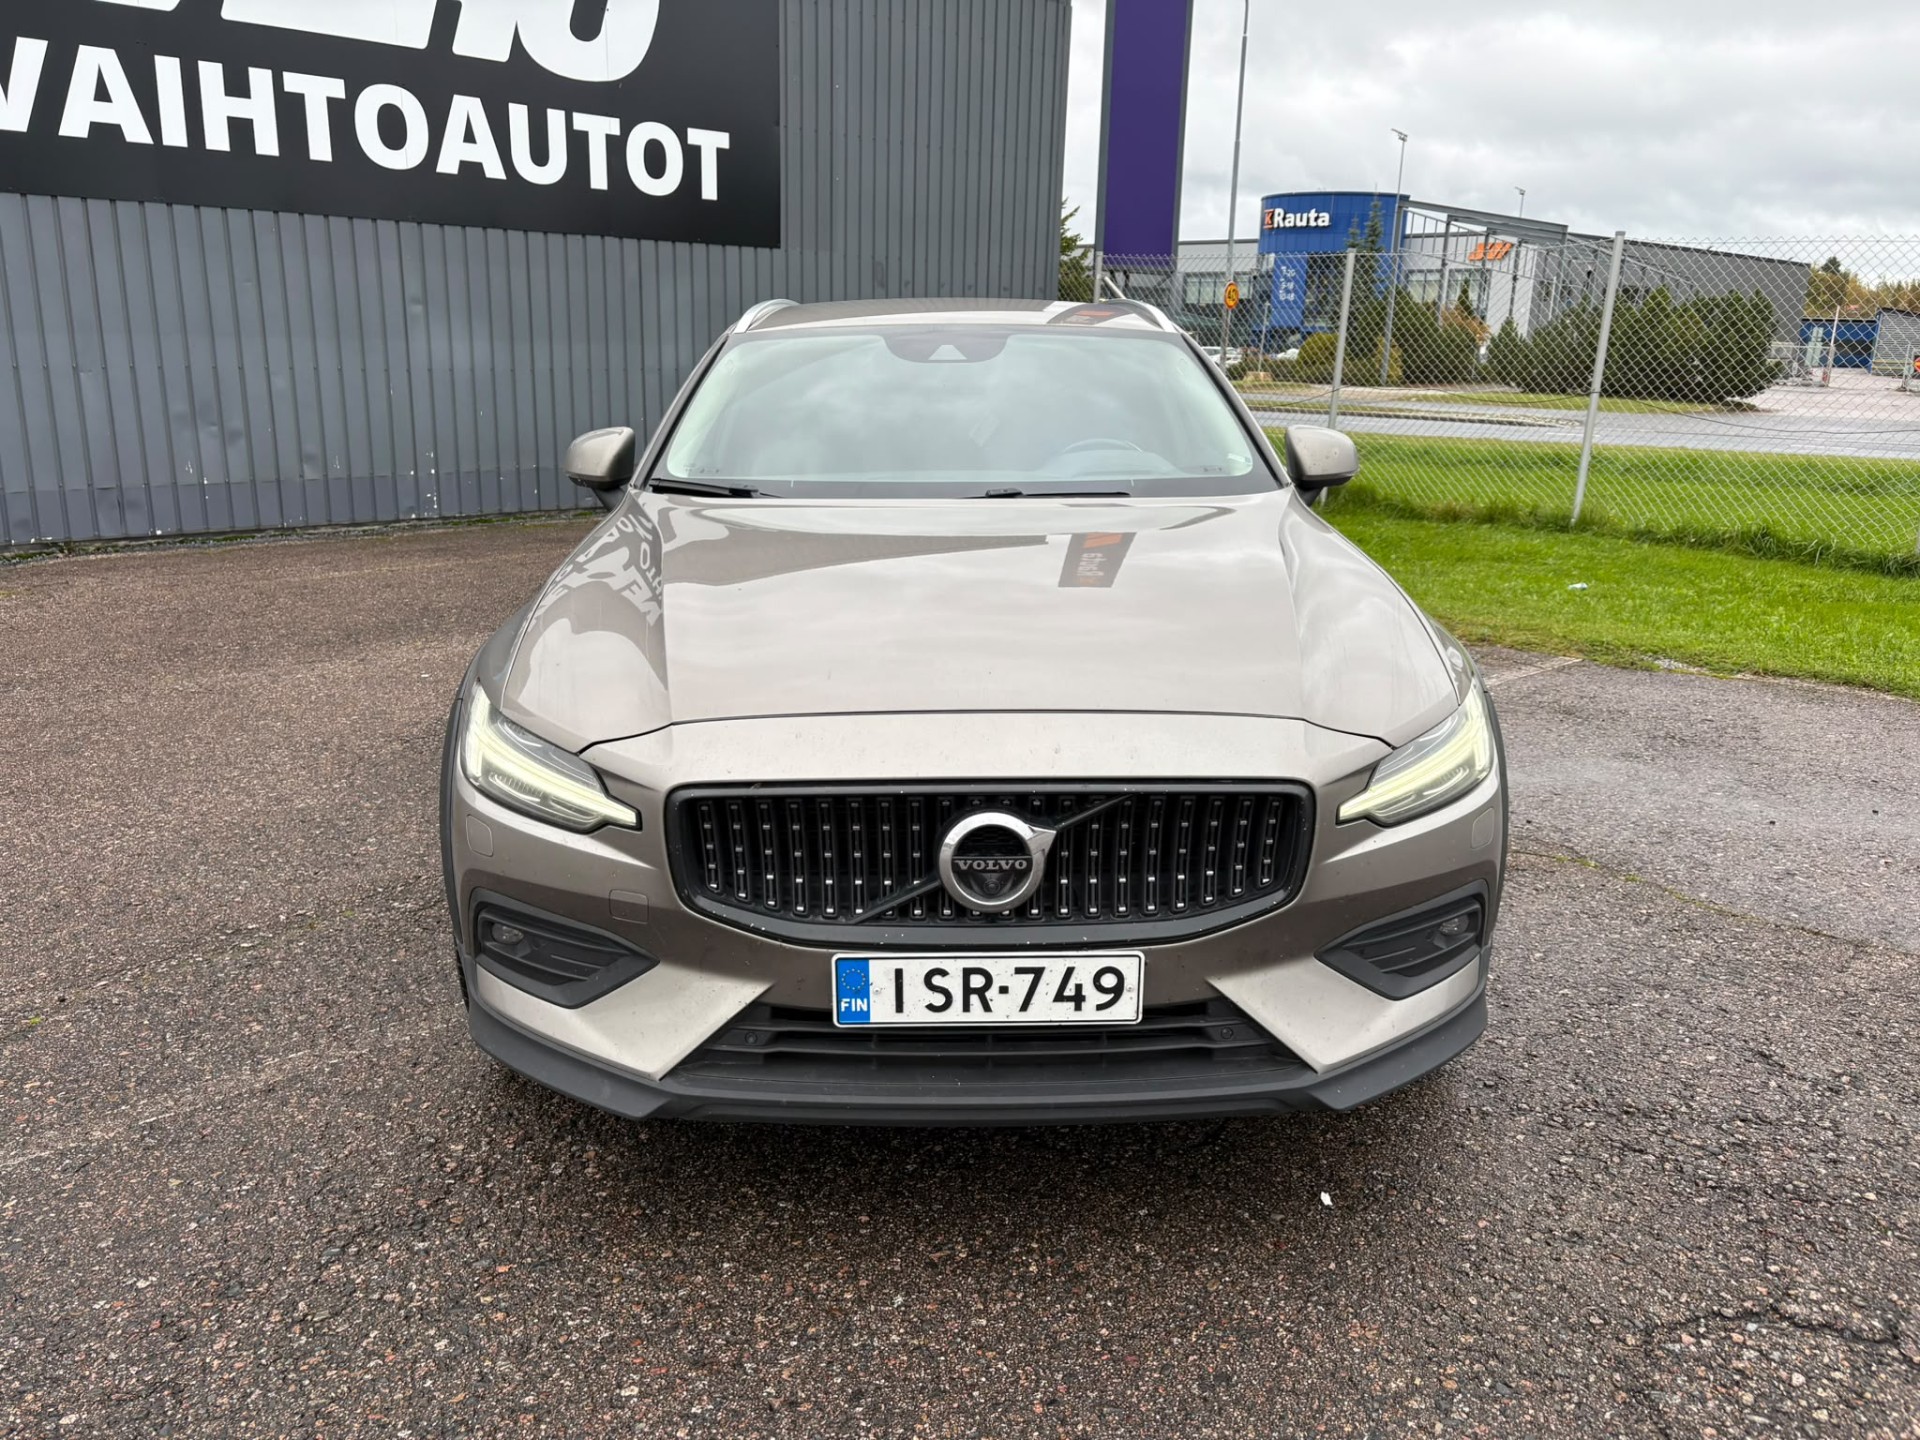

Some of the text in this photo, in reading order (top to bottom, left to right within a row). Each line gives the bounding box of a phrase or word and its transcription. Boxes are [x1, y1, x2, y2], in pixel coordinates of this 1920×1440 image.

[0, 37, 730, 200] VAIHTOAUTOT
[954, 860, 1028, 870] VOLVO
[894, 966, 1126, 1013] ISR-749
[841, 998, 868, 1012] FIN
